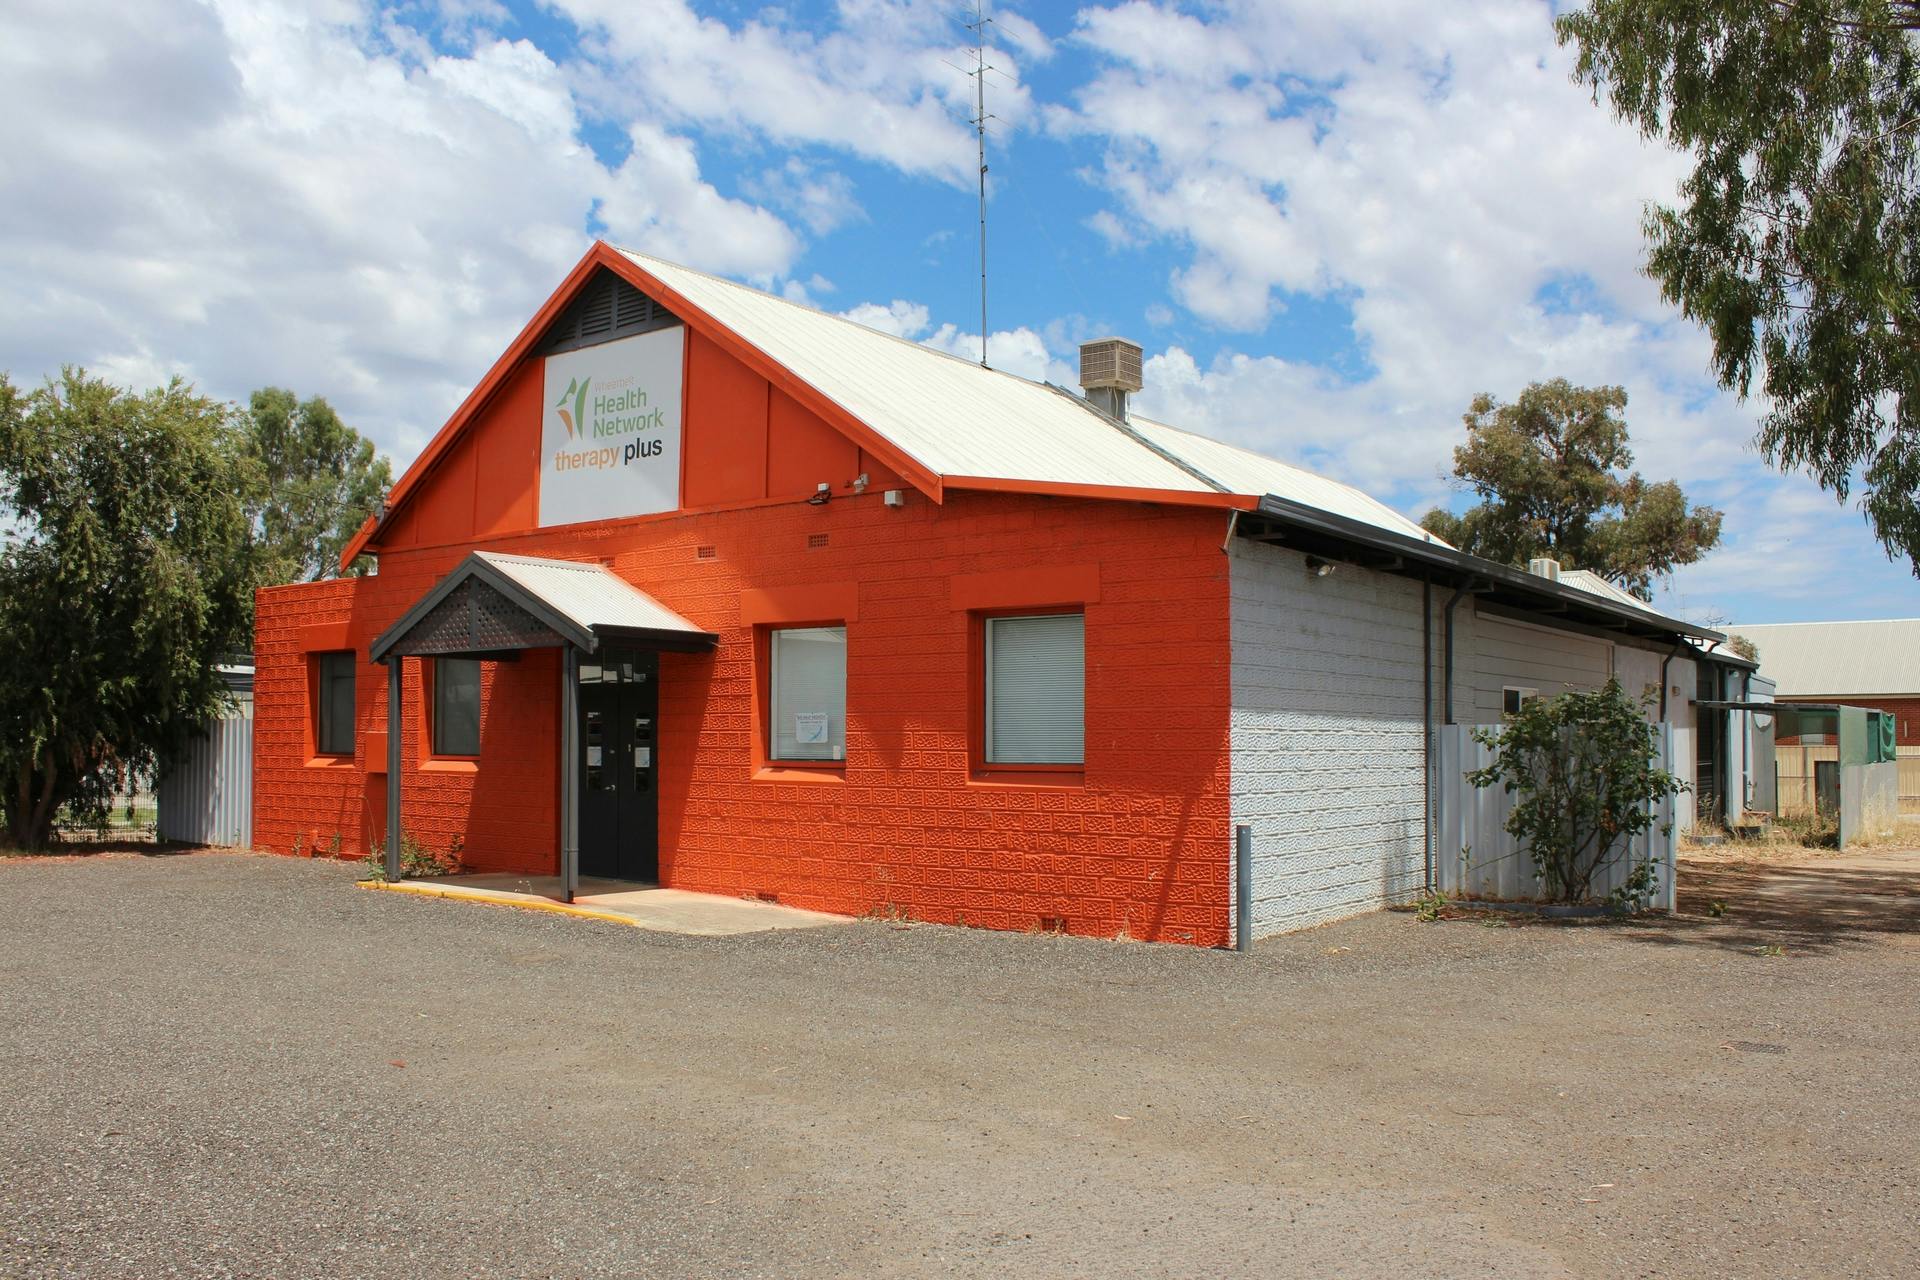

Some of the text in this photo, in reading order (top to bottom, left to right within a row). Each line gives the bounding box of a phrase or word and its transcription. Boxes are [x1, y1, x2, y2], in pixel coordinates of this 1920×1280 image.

[594, 387, 647, 416] Health
[593, 407, 664, 438] Network
[555, 437, 663, 471] therapy plus
